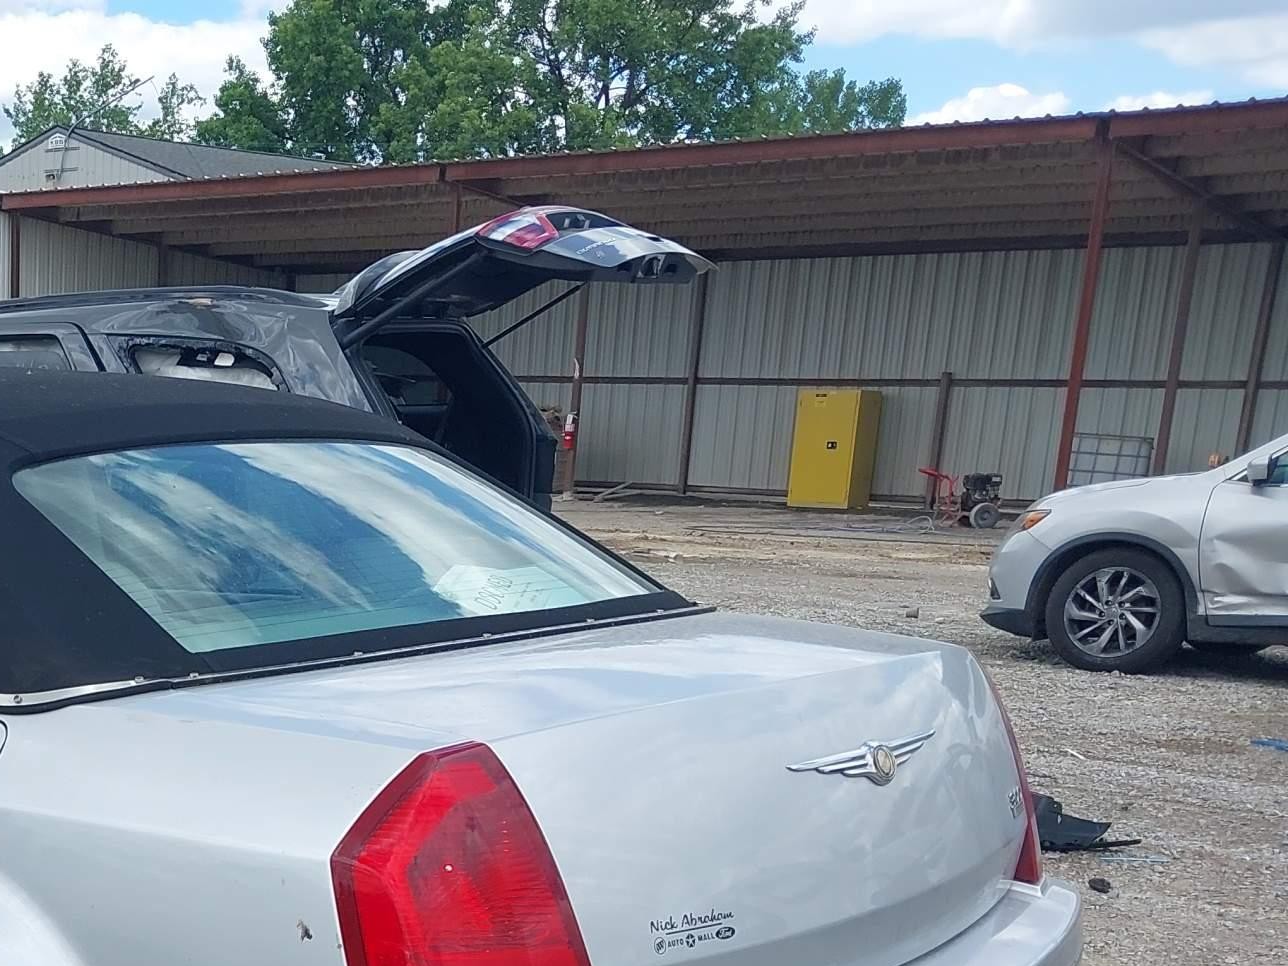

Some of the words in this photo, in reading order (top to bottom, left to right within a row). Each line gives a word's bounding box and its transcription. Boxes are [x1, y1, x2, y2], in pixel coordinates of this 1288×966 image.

[650, 916, 678, 934] Nick
[681, 908, 734, 928] Abraham
[667, 938, 684, 948] AUTO
[697, 932, 716, 942] MALL
